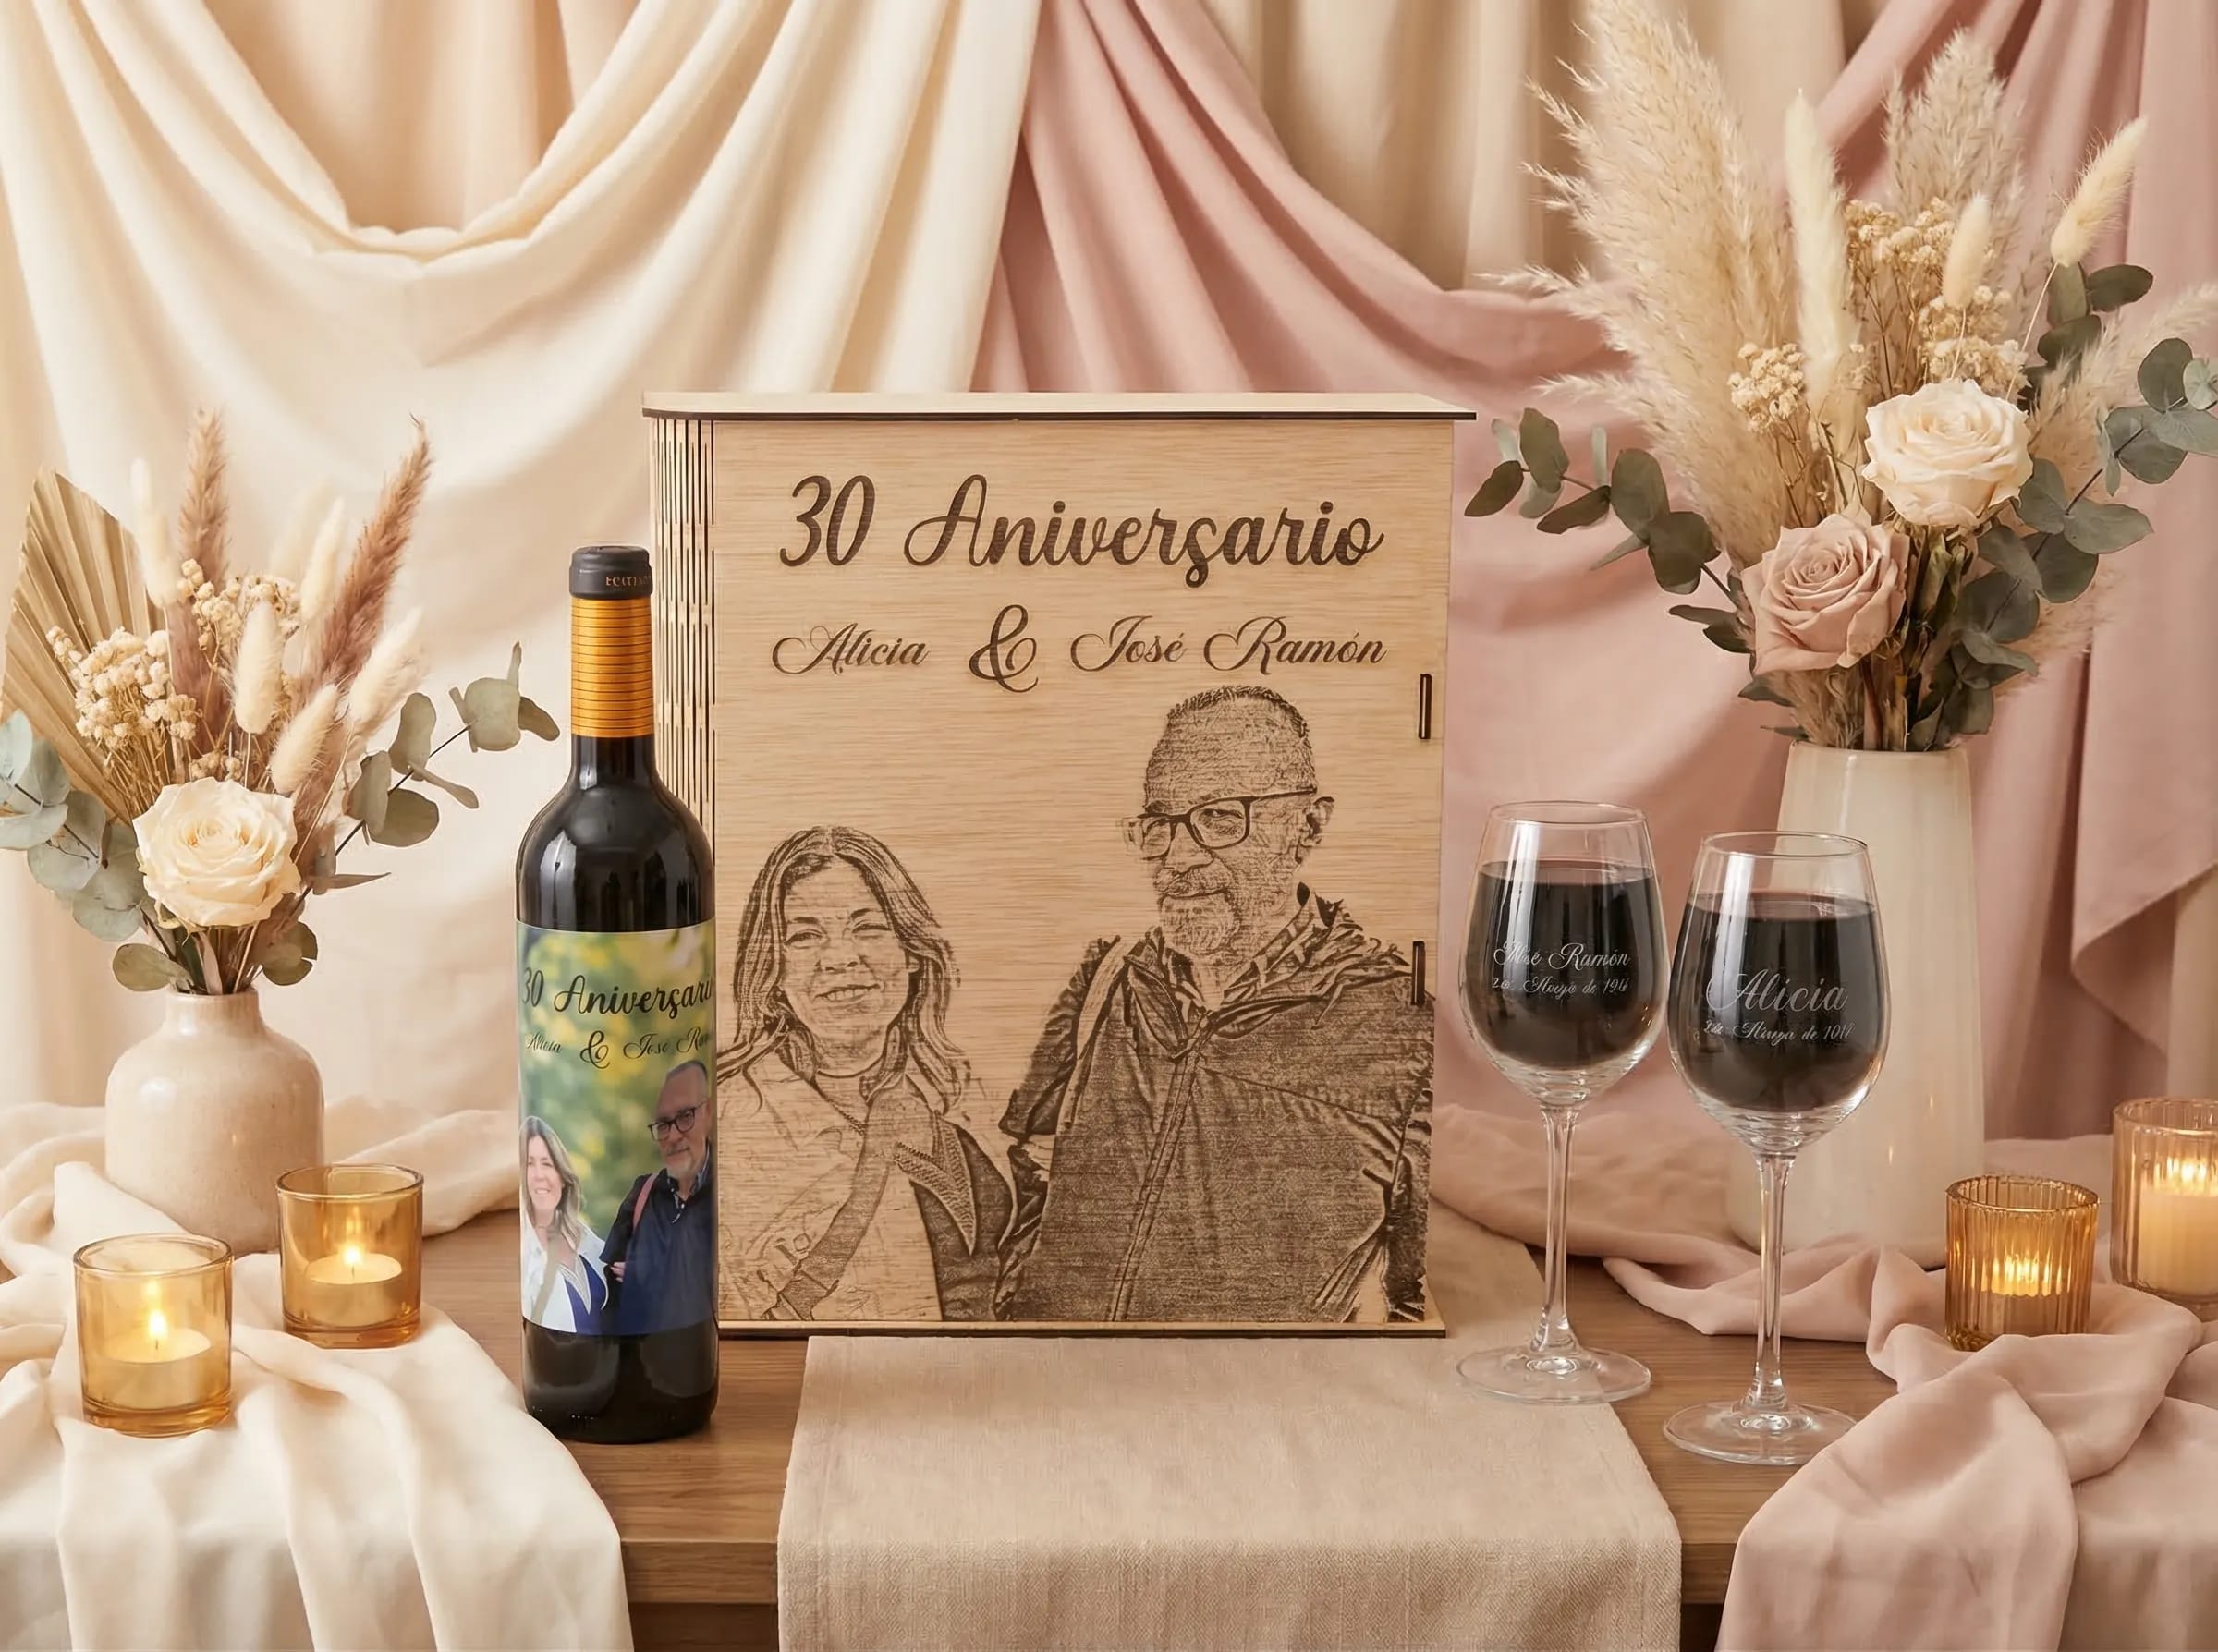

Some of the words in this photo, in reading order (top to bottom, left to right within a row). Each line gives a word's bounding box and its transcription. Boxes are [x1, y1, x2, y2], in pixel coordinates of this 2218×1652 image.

[778, 473, 877, 568] 30
[903, 472, 1385, 589] Aniversario
[771, 621, 930, 675] Alicia
[969, 603, 1040, 693] &
[1069, 615, 1187, 673] José
[1203, 616, 1388, 675] Ramón
[522, 967, 544, 1007] 30
[1706, 969, 1849, 1012] Alicia
[579, 1030, 610, 1069] &
